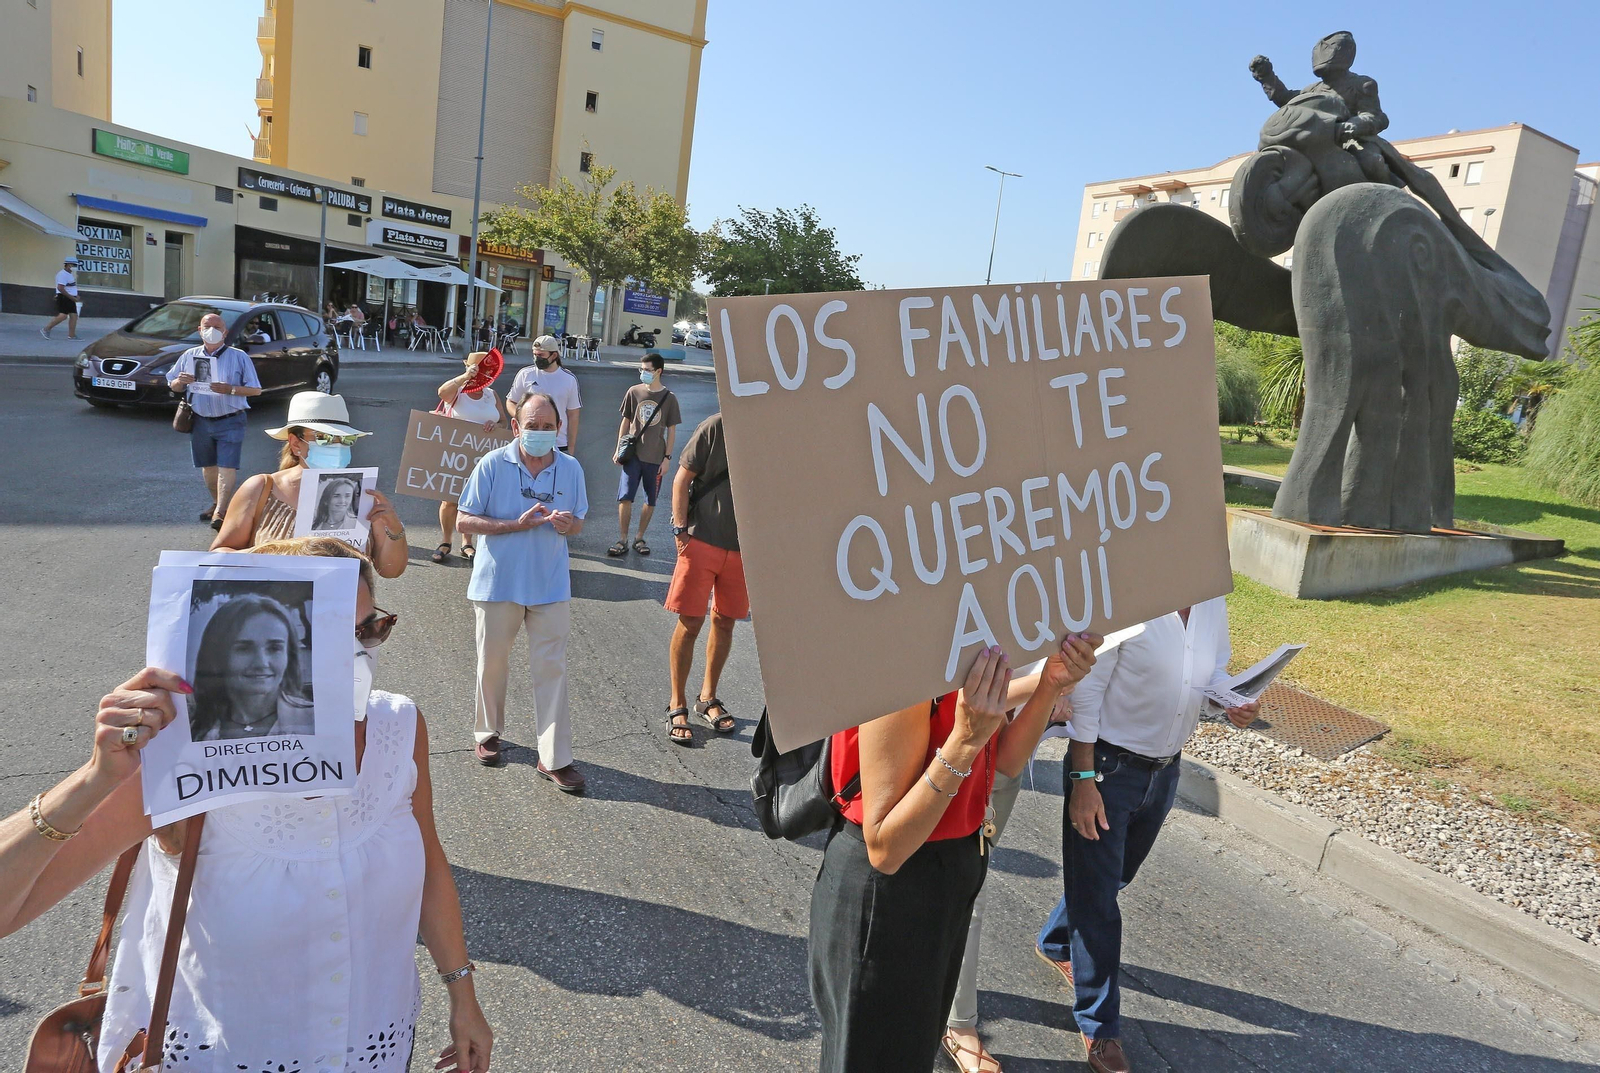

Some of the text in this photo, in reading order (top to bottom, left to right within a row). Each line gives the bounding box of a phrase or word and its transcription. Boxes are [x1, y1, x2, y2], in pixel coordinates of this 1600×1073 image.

[328, 190, 356, 209] PALUBA
[384, 201, 450, 225] Plata Jerez
[77, 225, 122, 240] ROXIMA
[387, 230, 416, 243] Plata
[417, 235, 445, 248] Jerez
[76, 243, 132, 260] APERTURA
[77, 260, 129, 275] RUTERIA
[720, 299, 856, 397] LOS
[97, 378, 133, 388] 9149 GHP
[416, 421, 443, 443] LA
[867, 367, 1129, 497] NO TE
[440, 450, 468, 472] NO
[313, 530, 351, 538] DIRECTORA
[836, 451, 1171, 601] QUEREMOS
[204, 739, 305, 758] DIRECTORA
[176, 756, 344, 801] DIMISIÓN
